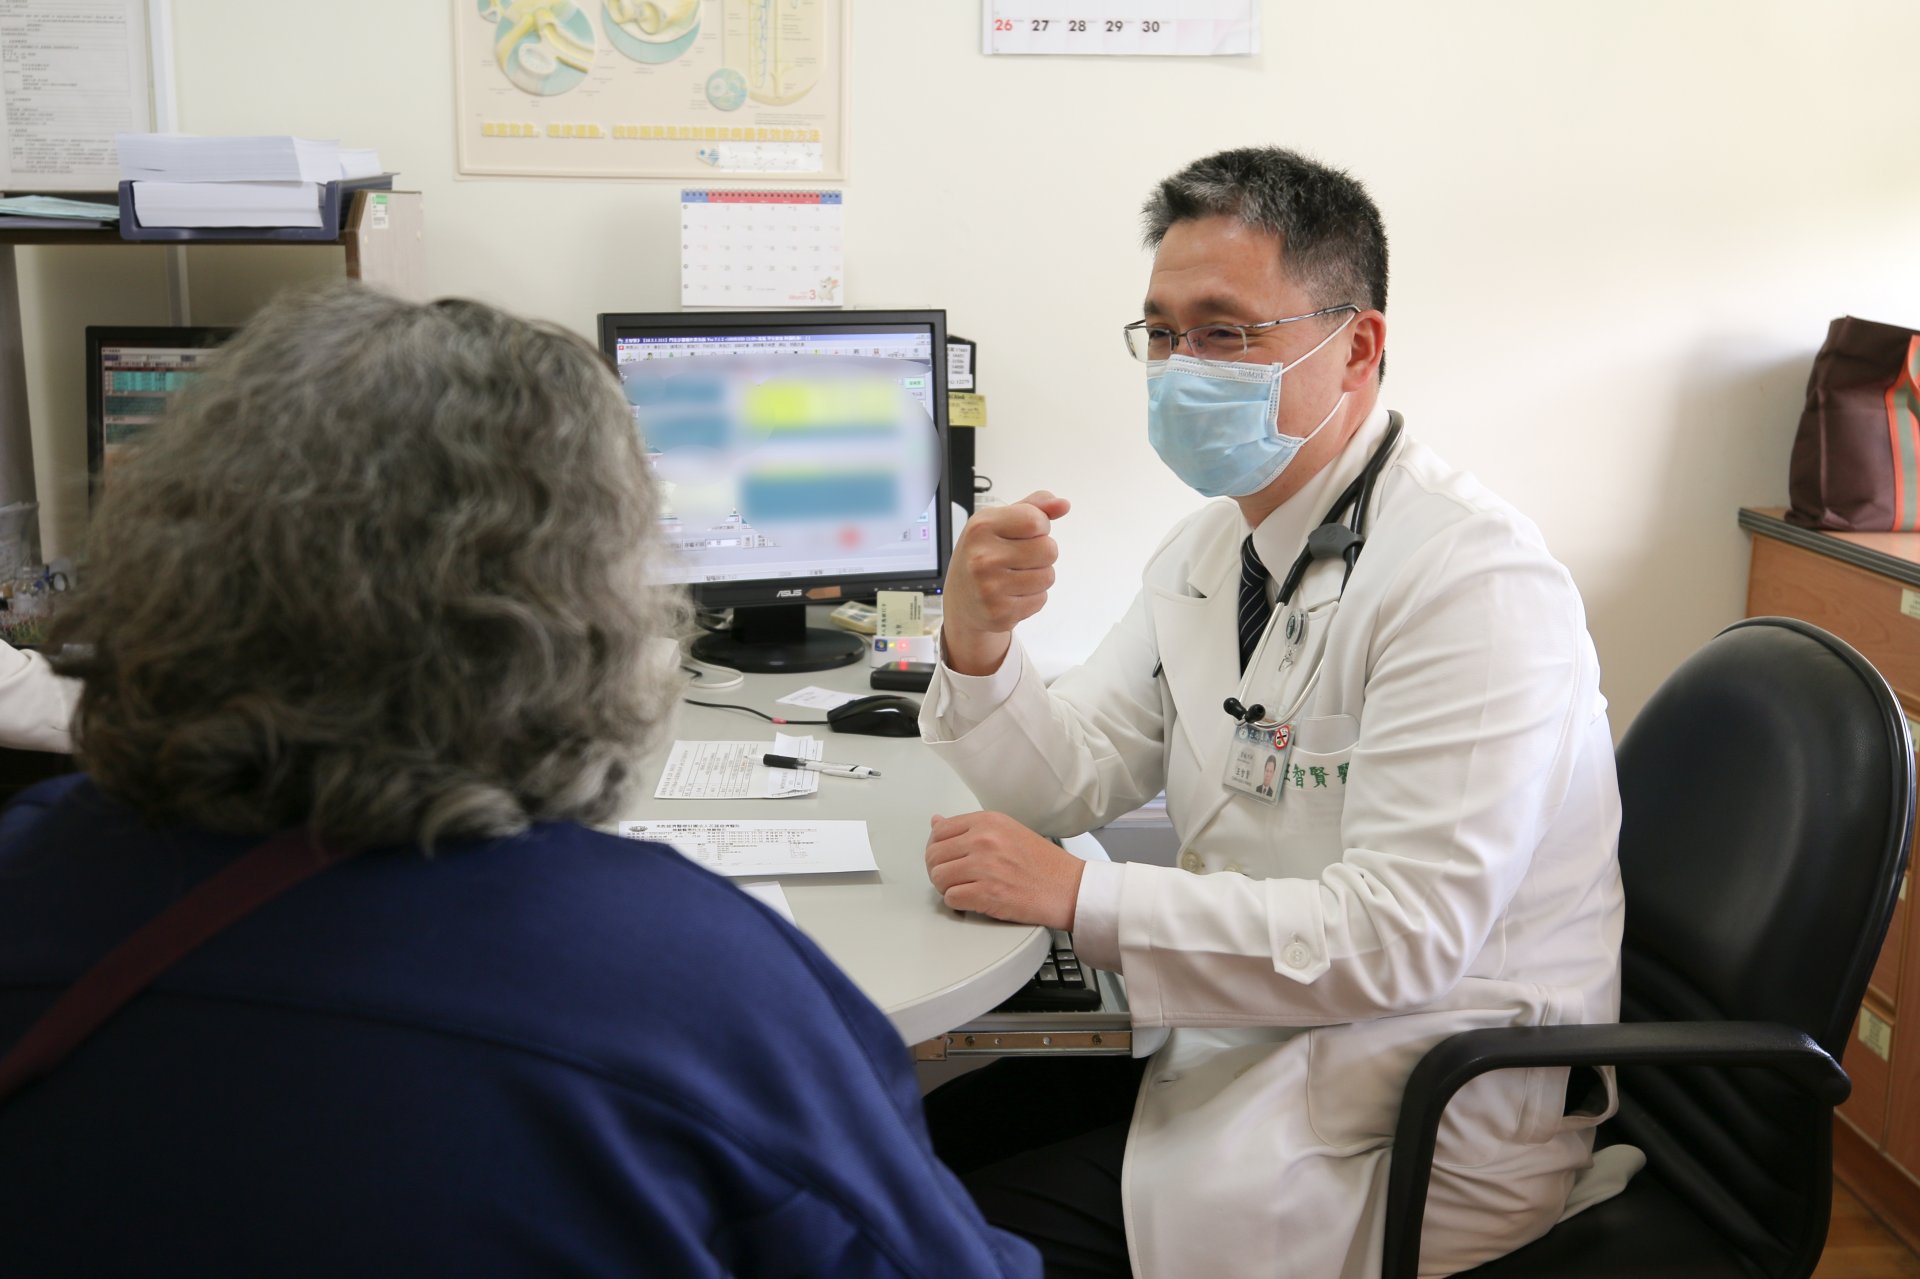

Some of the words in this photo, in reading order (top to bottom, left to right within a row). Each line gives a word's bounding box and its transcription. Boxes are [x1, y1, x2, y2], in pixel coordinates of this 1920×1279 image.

[994, 19, 1013, 31] 26
[1031, 19, 1050, 32] 27
[1068, 20, 1087, 32] 28
[1105, 20, 1124, 33] 29
[1141, 21, 1160, 33] 30
[809, 289, 817, 300] 3
[776, 589, 802, 598] ASUS
